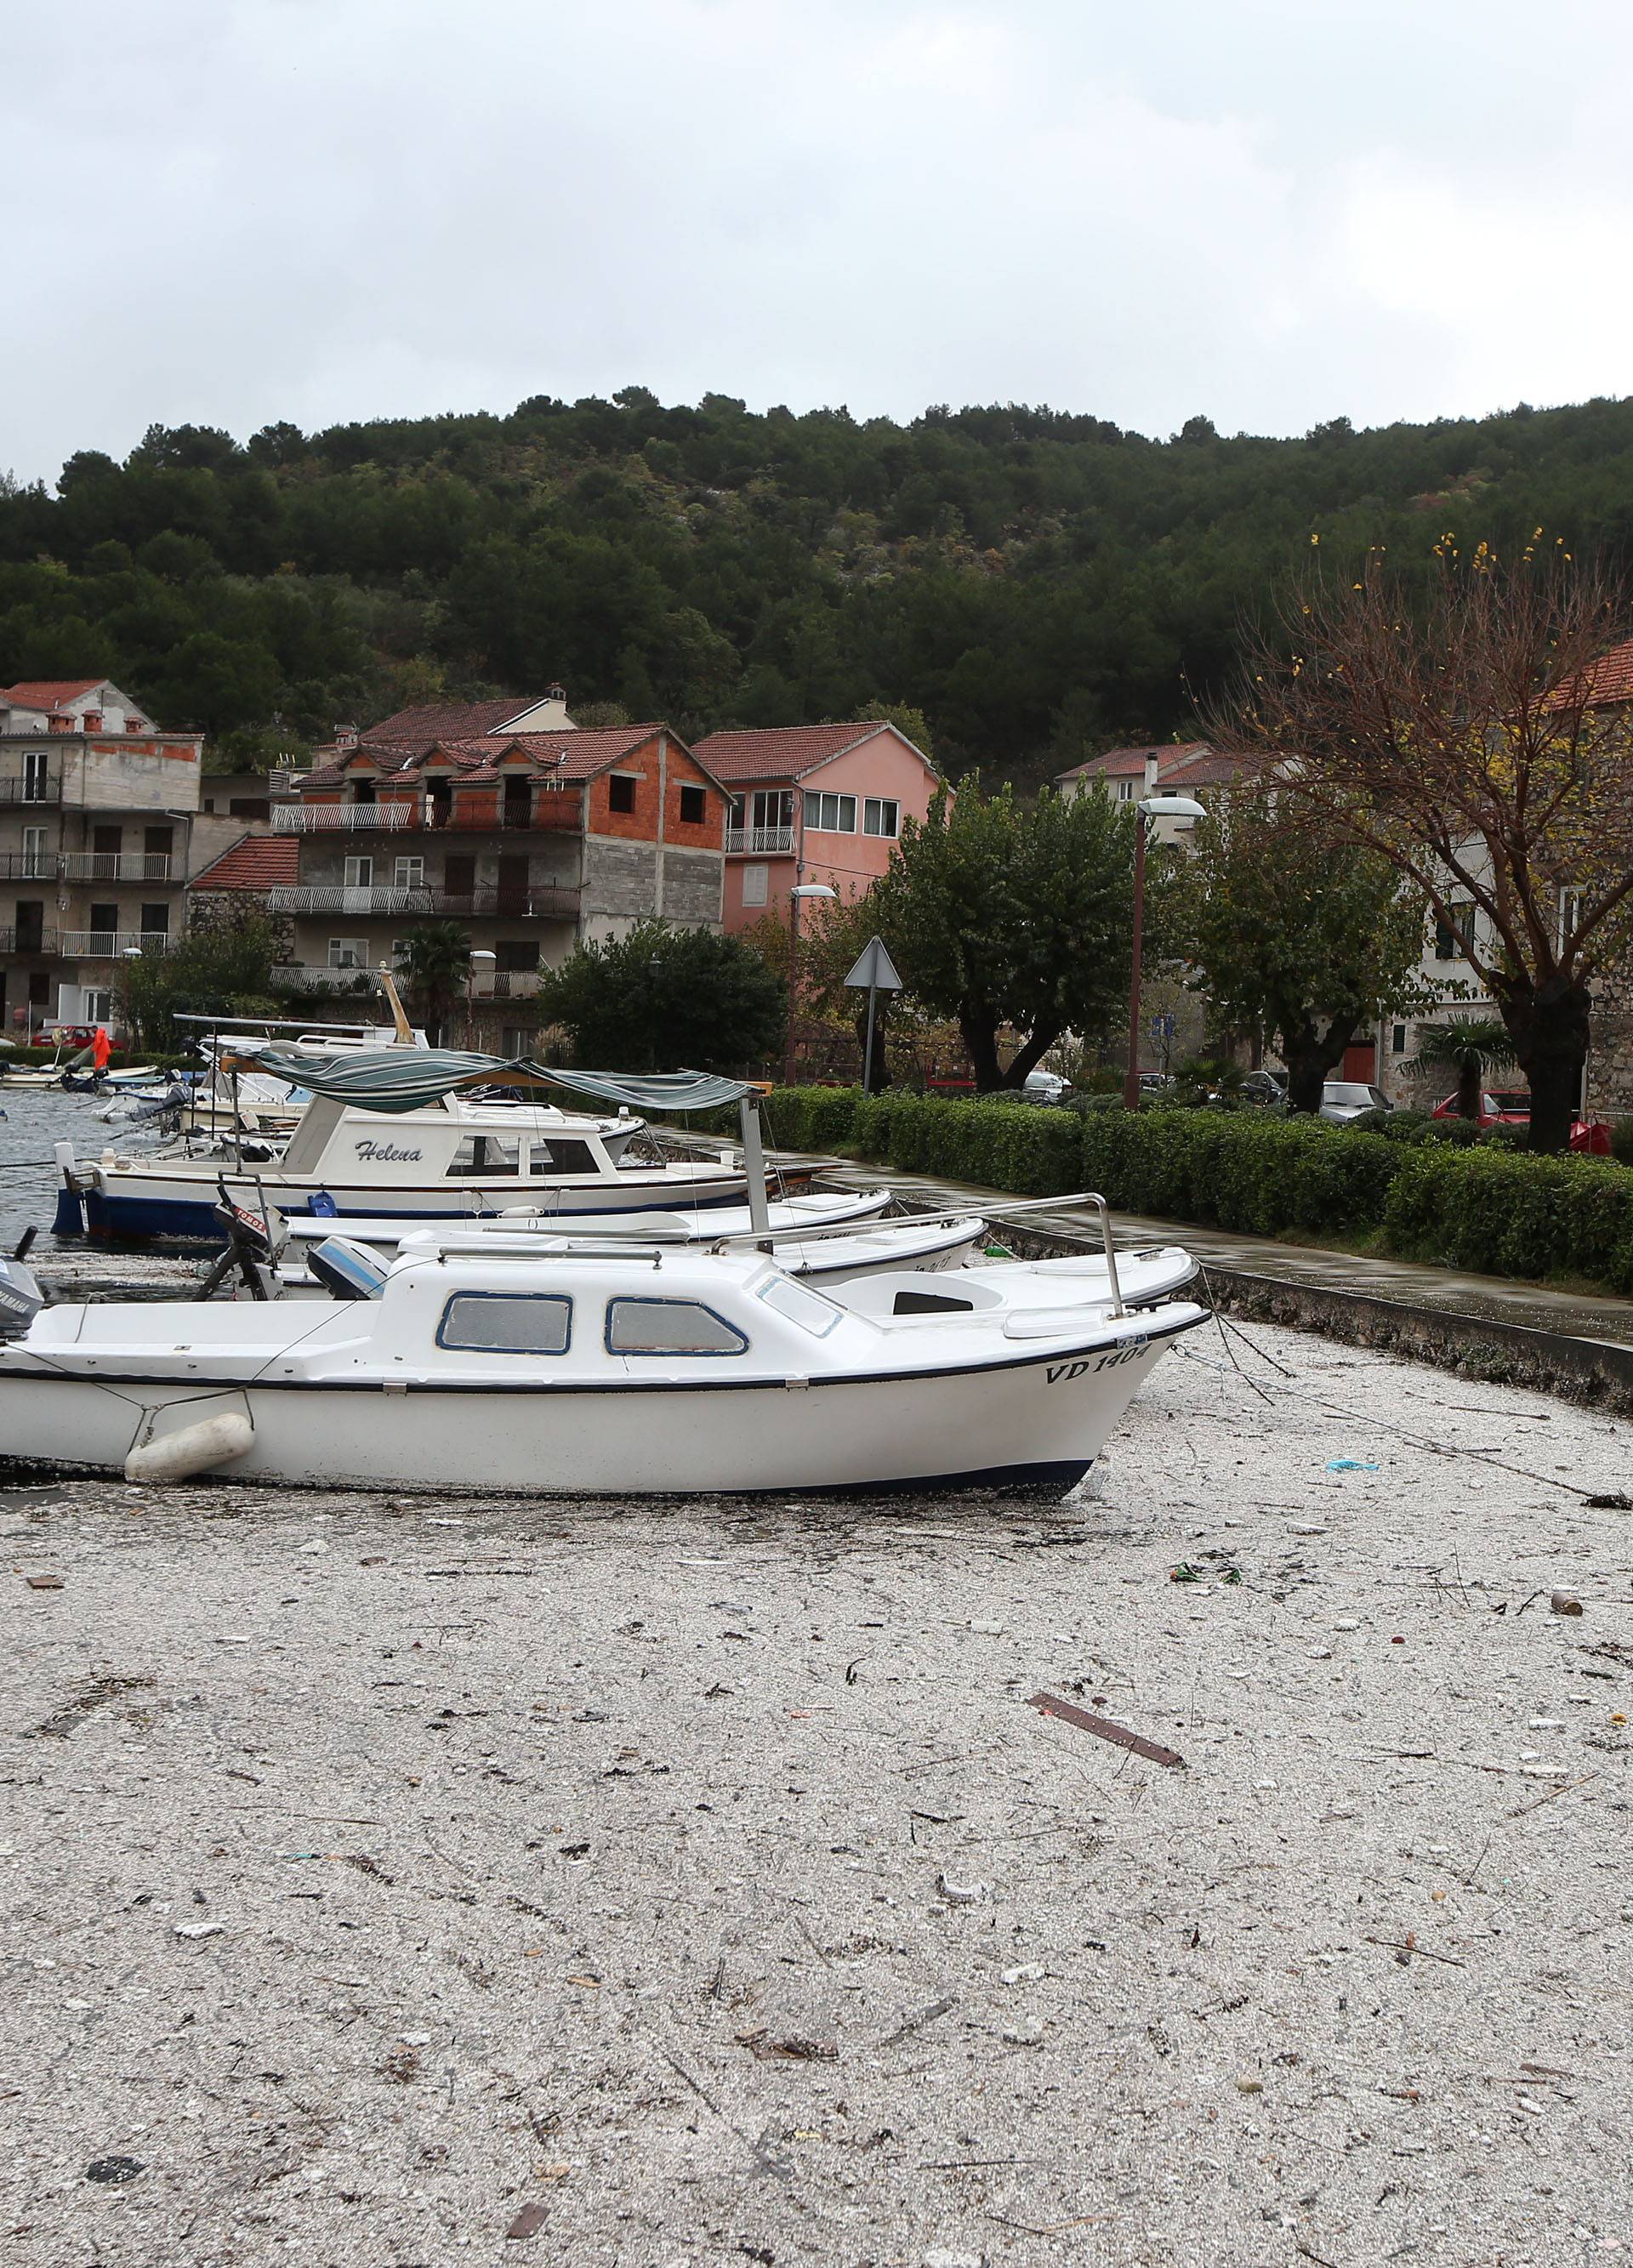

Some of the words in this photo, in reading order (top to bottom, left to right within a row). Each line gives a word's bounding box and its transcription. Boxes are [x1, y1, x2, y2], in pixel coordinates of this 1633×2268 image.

[355, 1140, 423, 1162] Helena
[237, 1209, 264, 1231] TOMOS
[1045, 1361, 1090, 1384] VD
[1093, 1343, 1153, 1373] 1404
